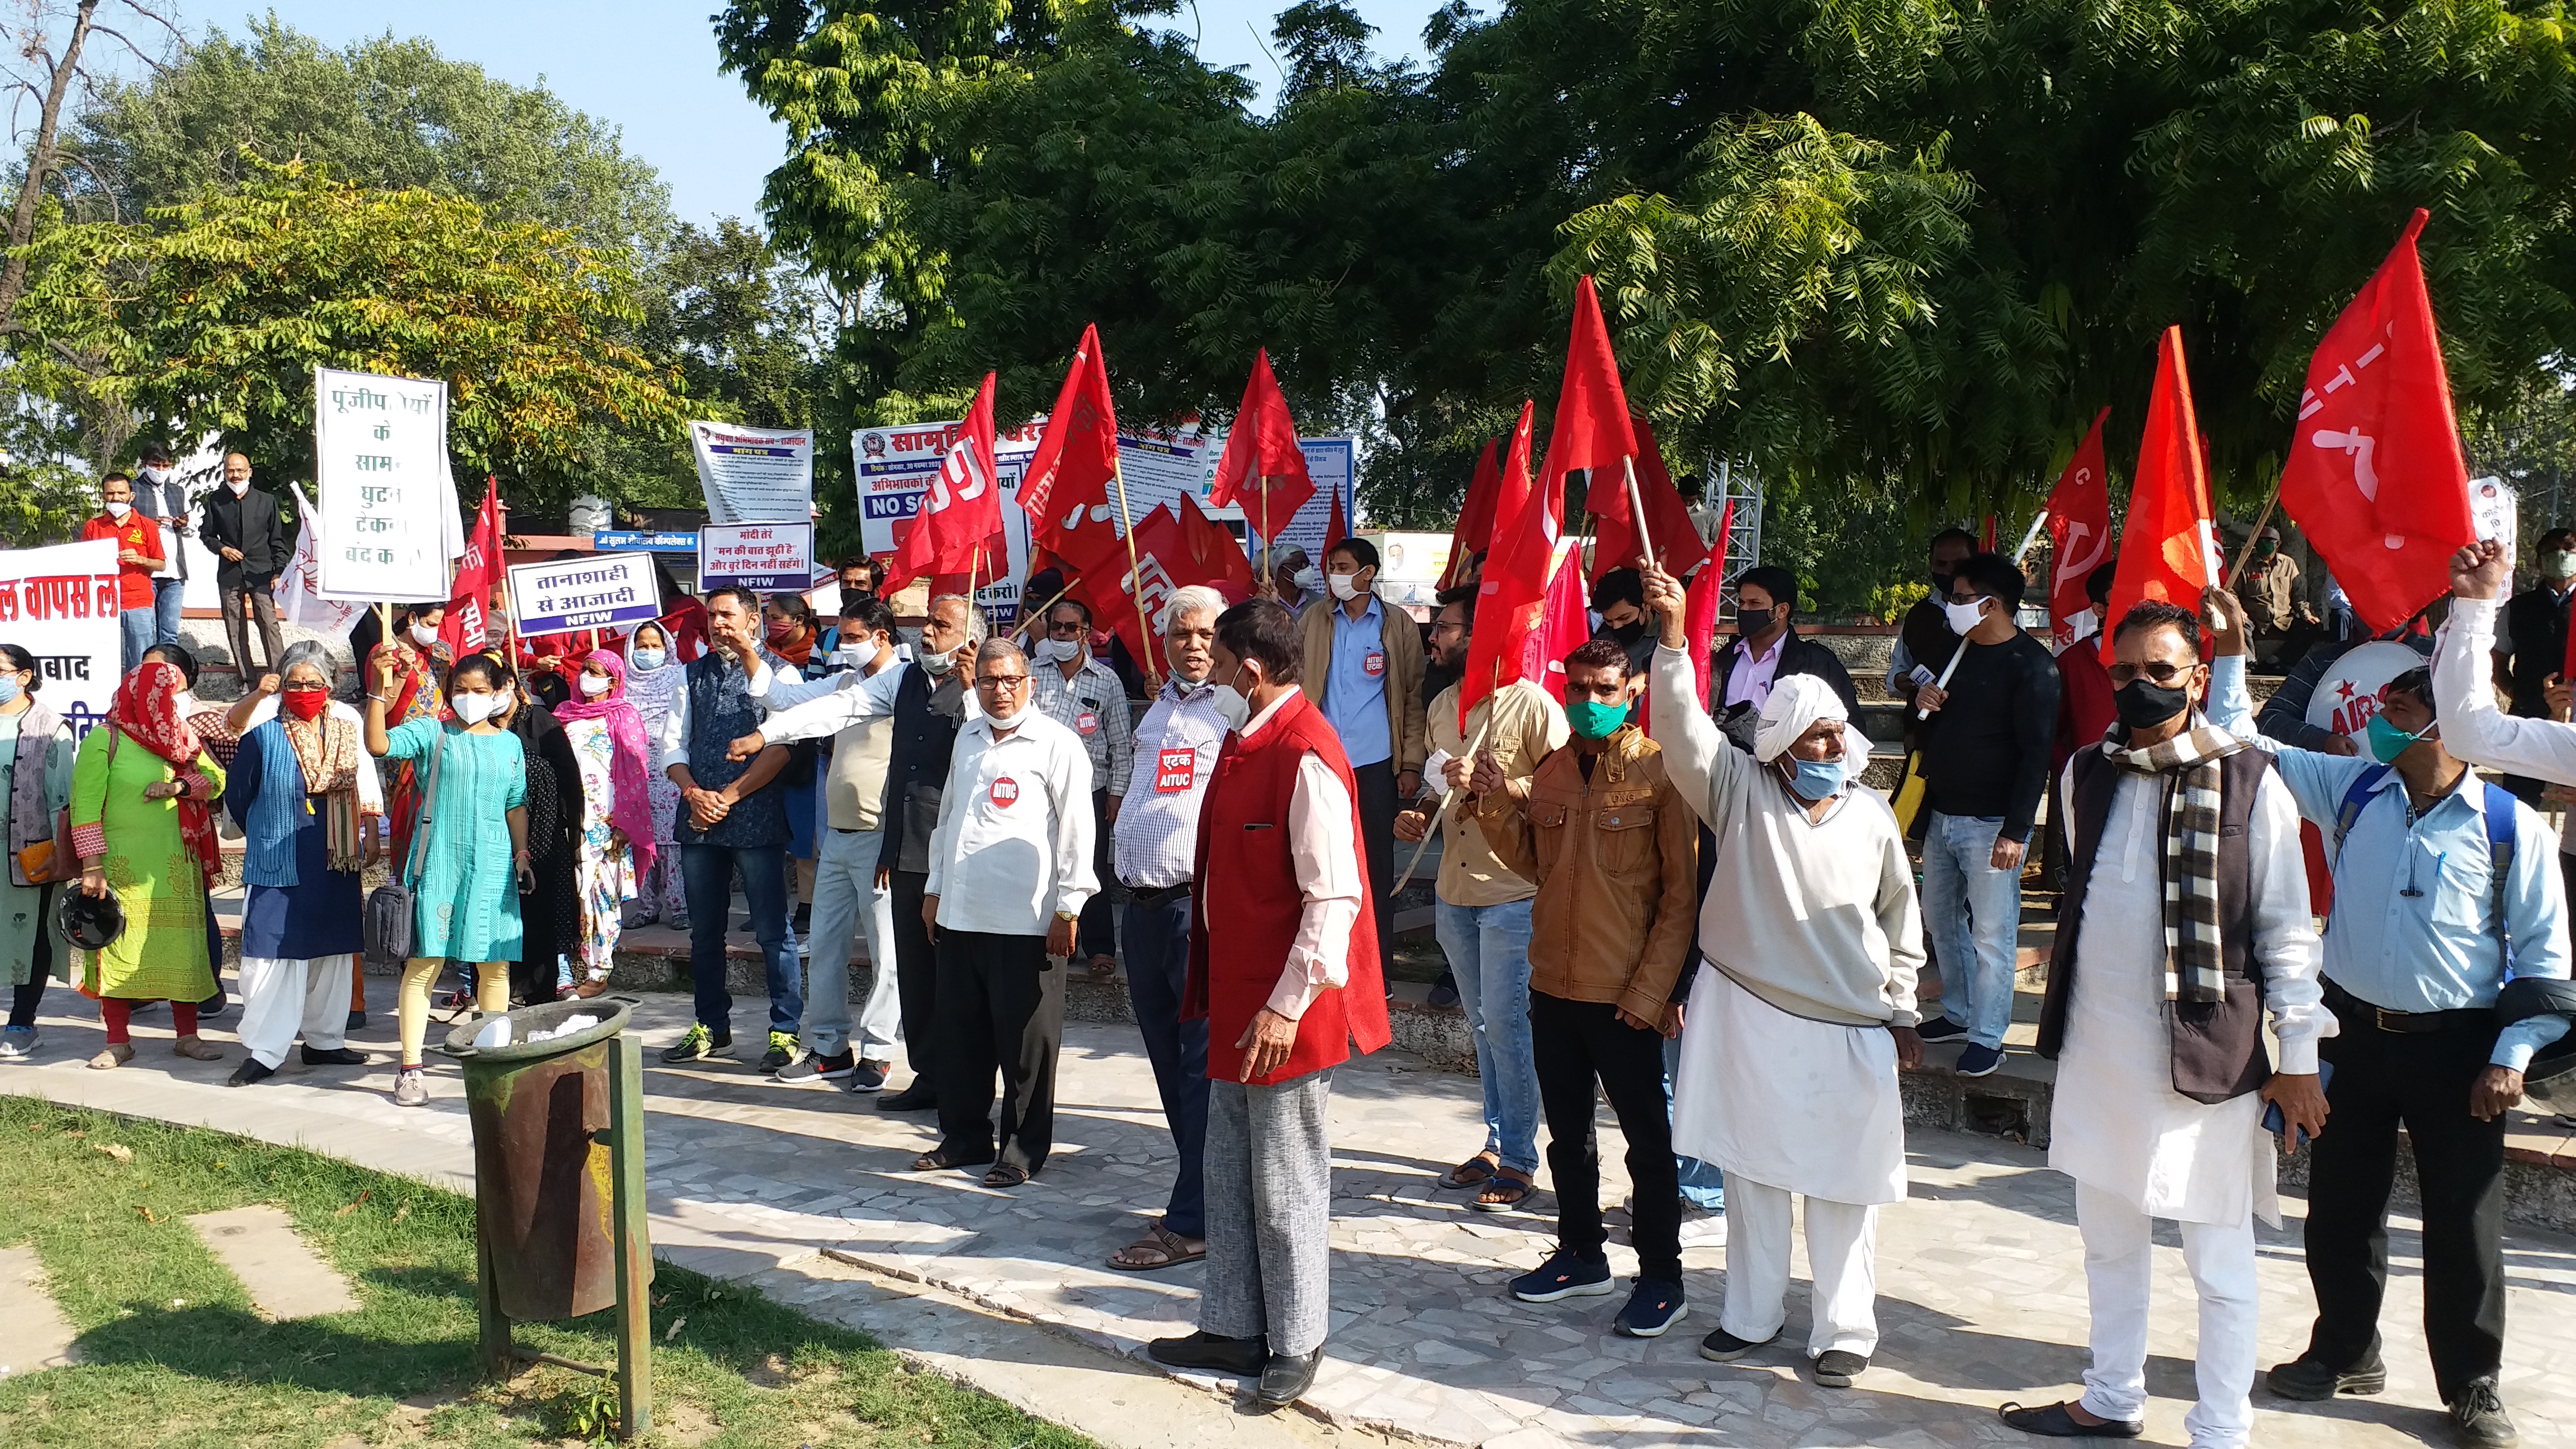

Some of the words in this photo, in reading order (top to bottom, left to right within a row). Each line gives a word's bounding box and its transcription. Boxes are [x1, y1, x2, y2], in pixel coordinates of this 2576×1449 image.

[373, 420, 391, 441] के
[780, 437, 806, 446] राजस्थान
[872, 497, 900, 516] NO
[627, 533, 654, 546] शौचालय
[740, 529, 759, 540] मोदी
[761, 528, 774, 539] तेरे
[345, 541, 373, 564] बंद
[734, 544, 746, 556] की
[747, 546, 764, 555] बात
[765, 544, 784, 557] झूठी
[709, 560, 727, 570] और
[728, 559, 741, 572] बुरे
[742, 560, 758, 570] दिन
[760, 558, 778, 570] नहीं
[535, 564, 629, 590] तानाशाही
[738, 577, 775, 587] NFIW
[23, 574, 92, 621] वापस
[536, 595, 555, 613] से
[560, 586, 636, 610] आजादी
[565, 610, 613, 627] NFIW
[987, 608, 1014, 618] FIW
[1366, 656, 1384, 664] AITUC
[1366, 662, 1384, 671] एटक
[1079, 716, 1096, 728] AITUC
[1162, 754, 1192, 771] एटक
[1159, 773, 1190, 787] AITUC
[993, 782, 1016, 799] AITUC
